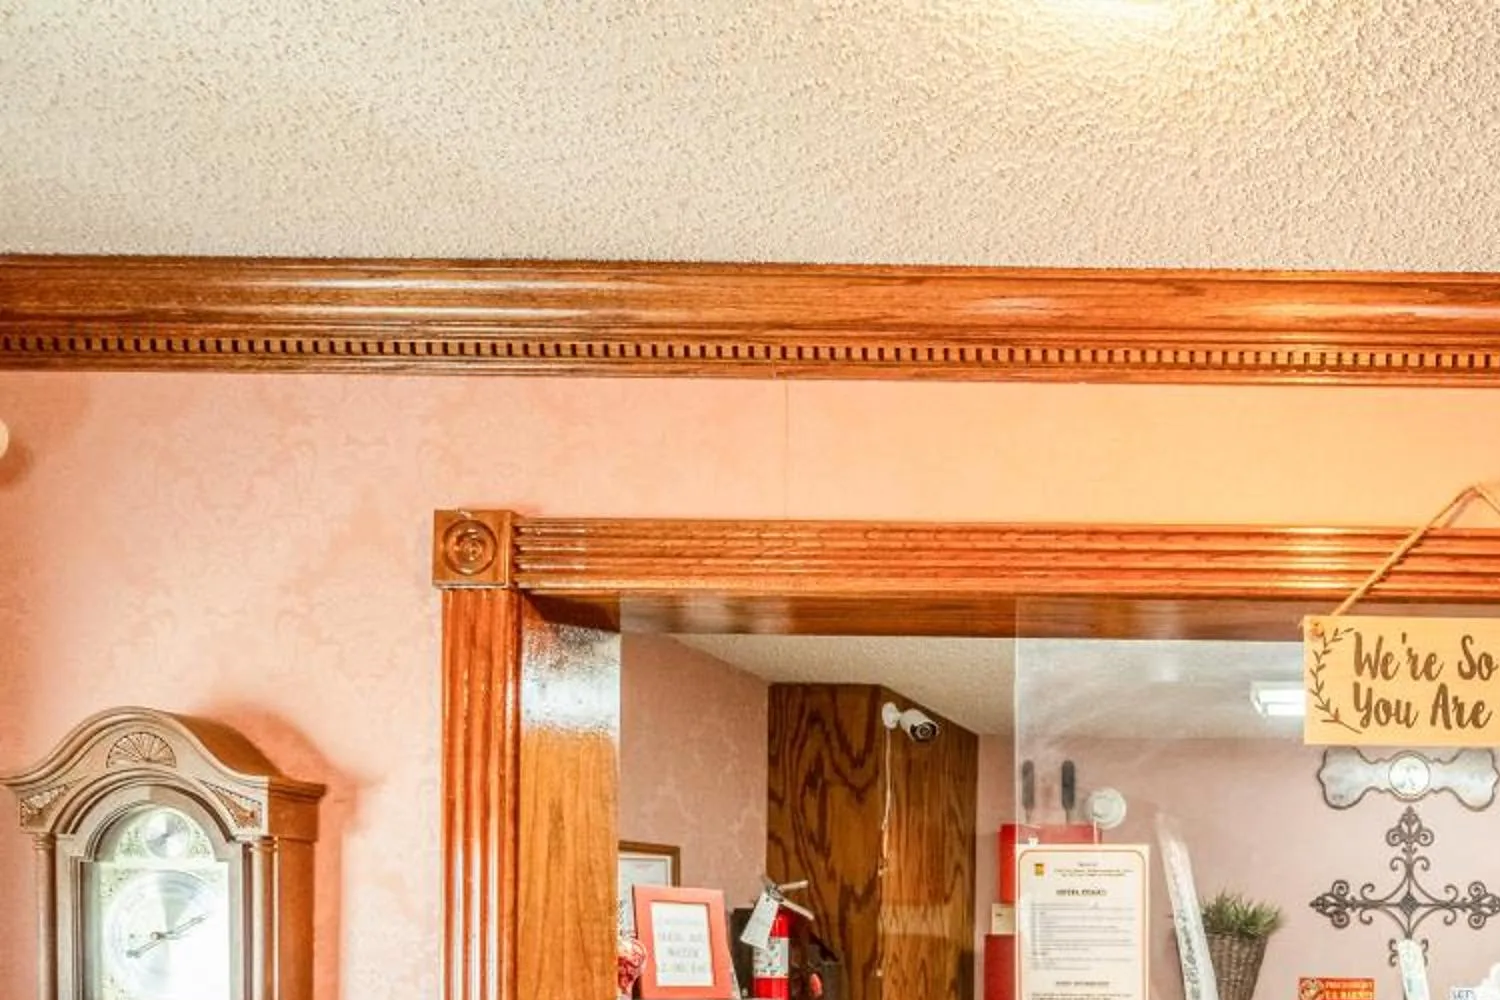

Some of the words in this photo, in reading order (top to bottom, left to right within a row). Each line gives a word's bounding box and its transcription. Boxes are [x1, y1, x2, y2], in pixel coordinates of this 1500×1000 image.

[1353, 631, 1444, 682] We're
[1457, 634, 1499, 681] So
[1352, 682, 1420, 729] You
[1430, 683, 1493, 731] Are
